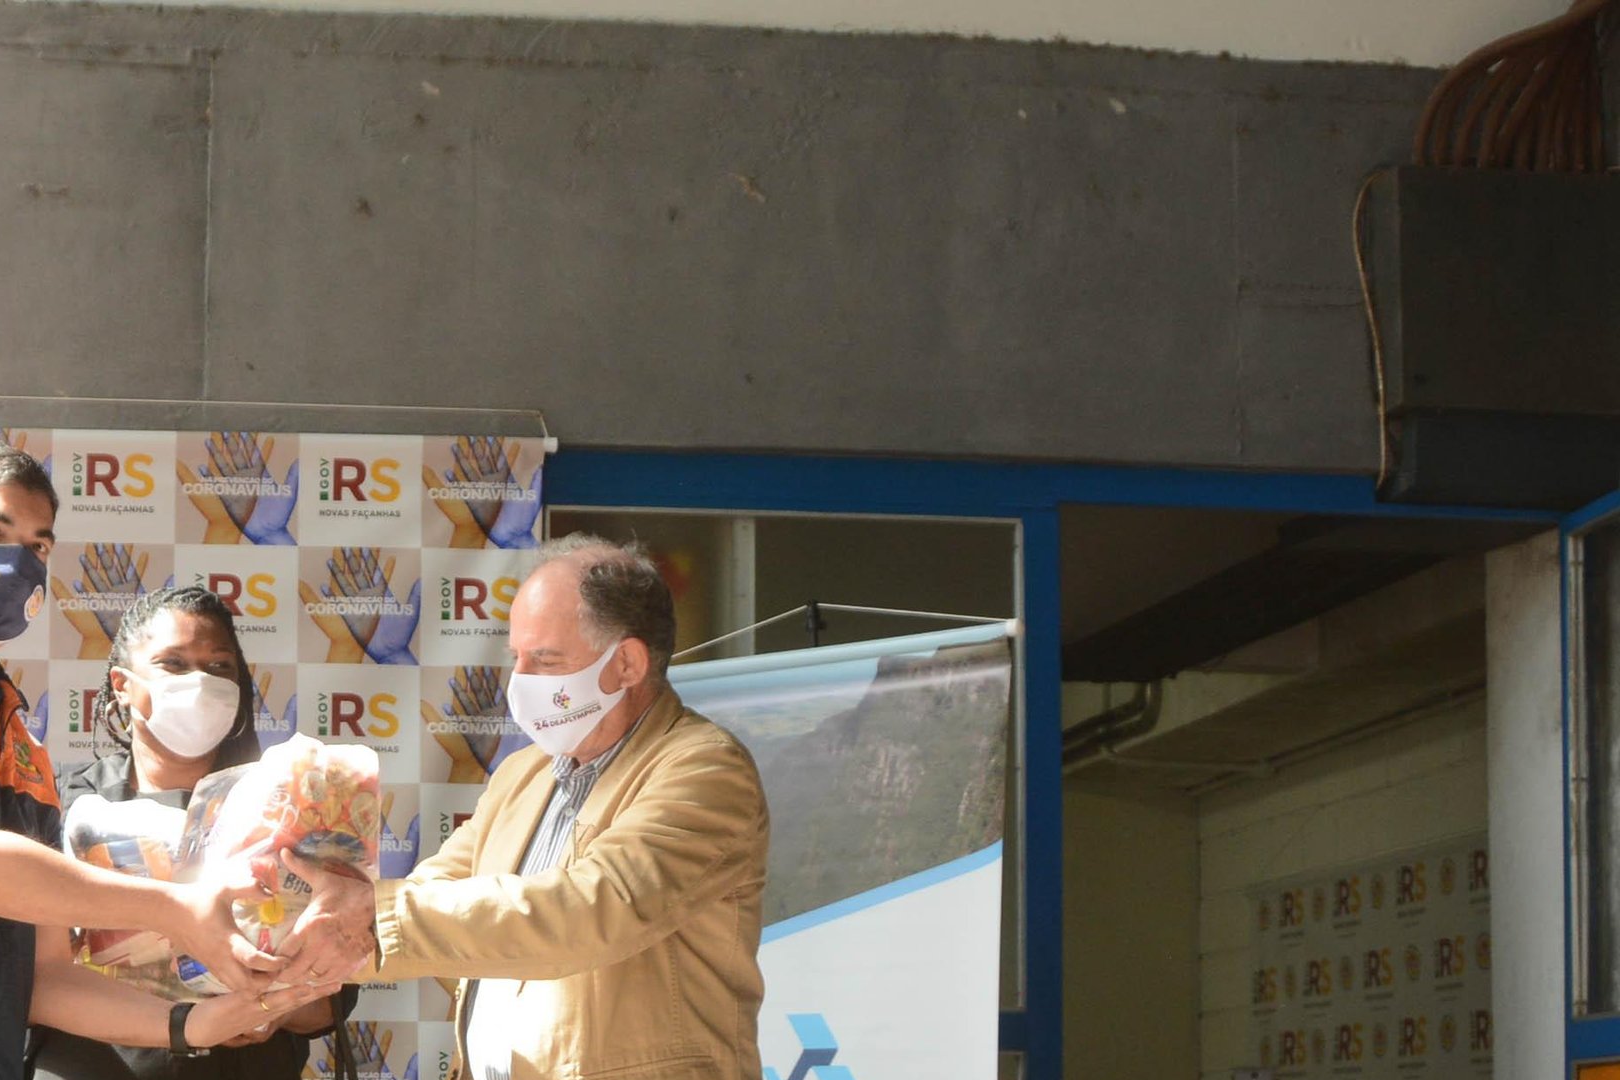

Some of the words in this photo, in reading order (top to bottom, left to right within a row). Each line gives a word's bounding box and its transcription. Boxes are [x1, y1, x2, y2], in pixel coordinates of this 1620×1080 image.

[72, 453, 82, 484] GOV
[86, 453, 155, 498] RS
[320, 458, 329, 489] GOV
[333, 458, 401, 503] RS
[72, 504, 103, 512] NOVAS
[105, 505, 155, 515] FAÇANHAS
[351, 510, 401, 520] FAÇANHAS
[209, 573, 278, 618] RS
[442, 578, 451, 608] GOV
[454, 577, 520, 622] RS
[235, 625, 277, 634] AÇANHAS
[474, 629, 510, 637] FAÇANH
[69, 689, 78, 721] GOV
[318, 693, 328, 724] GOV
[331, 693, 400, 738] RS
[361, 983, 398, 993] ÇANHAS
